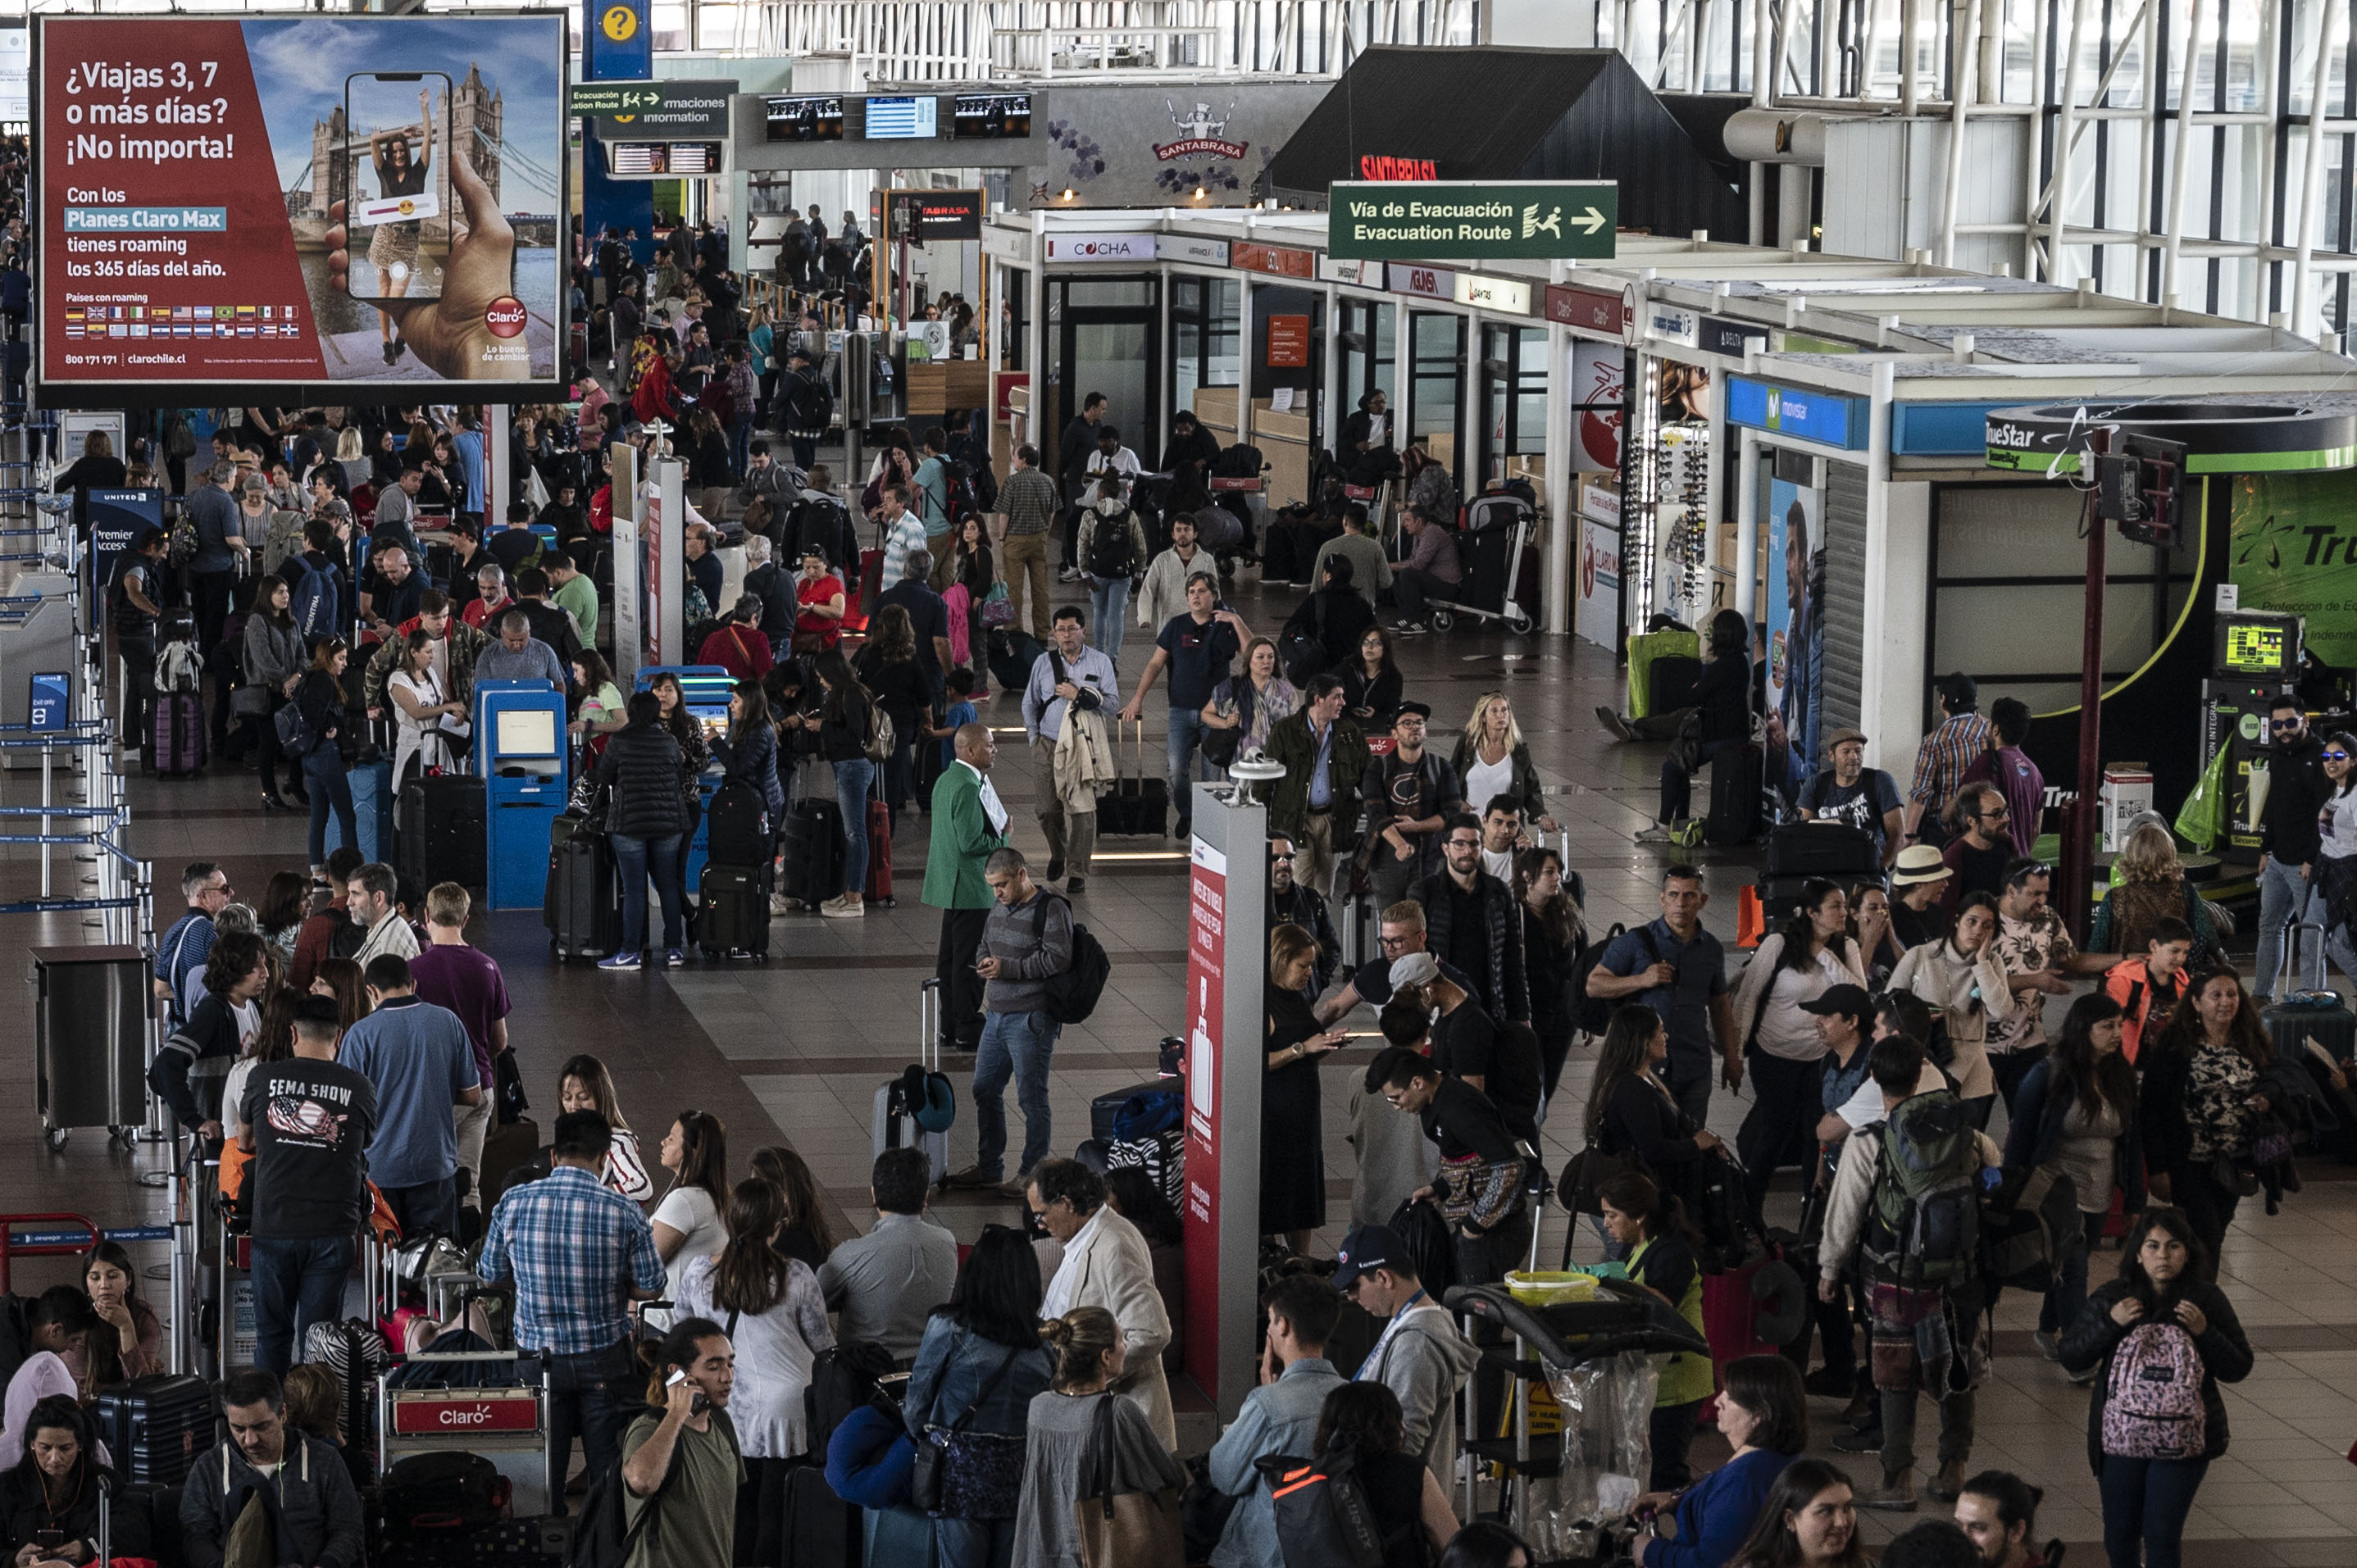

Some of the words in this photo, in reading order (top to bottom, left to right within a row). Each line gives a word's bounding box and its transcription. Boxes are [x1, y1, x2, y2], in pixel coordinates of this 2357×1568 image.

[66, 61, 164, 94] ¿Viajas
[170, 61, 194, 93] 3,
[201, 61, 218, 88] 7
[574, 91, 619, 99] Evacuación
[66, 104, 82, 124] o
[90, 96, 148, 124] más
[155, 96, 228, 124] días?
[664, 98, 726, 108] rmaciones
[644, 111, 708, 122] Information
[67, 134, 113, 165] ¡No
[120, 134, 234, 165] importa!
[1159, 141, 1241, 159] SANTABRASA
[67, 187, 98, 202] Con
[102, 187, 126, 202] los
[1349, 202, 1377, 217] Vía
[1382, 202, 1404, 217] de
[1410, 202, 1513, 217] Evacuación
[68, 210, 129, 227] Planes
[132, 210, 179, 227] Claro
[183, 210, 221, 227] Max
[1354, 225, 1453, 240] Evacuation
[1458, 225, 1512, 240] Route
[67, 236, 116, 252] tienes
[121, 236, 187, 255] roaming
[67, 261, 91, 276] los
[94, 261, 124, 276] 365
[127, 259, 160, 276] días
[164, 260, 189, 276] del
[192, 259, 226, 276] año.
[66, 292, 94, 302] Países
[112, 293, 148, 304] roaming
[1473, 288, 1491, 300] QANTAS
[487, 310, 522, 322] Claro
[1726, 331, 1741, 348] DELTA
[486, 344, 498, 353] Lo
[499, 344, 526, 353] bueno
[66, 354, 84, 364] 800
[85, 354, 99, 365] 171
[102, 354, 117, 365] 171
[128, 353, 186, 364] clarochile.cl
[482, 352, 493, 361] de
[494, 352, 530, 361] cambiar
[1781, 400, 1808, 420] movistar
[2262, 601, 2322, 612] Proteccion
[2326, 601, 2341, 611] de
[304, 595, 321, 637] ARGENTINA
[44, 699, 56, 707] only
[2209, 699, 2218, 739] INTEGRAL
[269, 1079, 305, 1098] SEMA
[311, 1084, 352, 1107] SHOW
[440, 1407, 488, 1424] Claro
